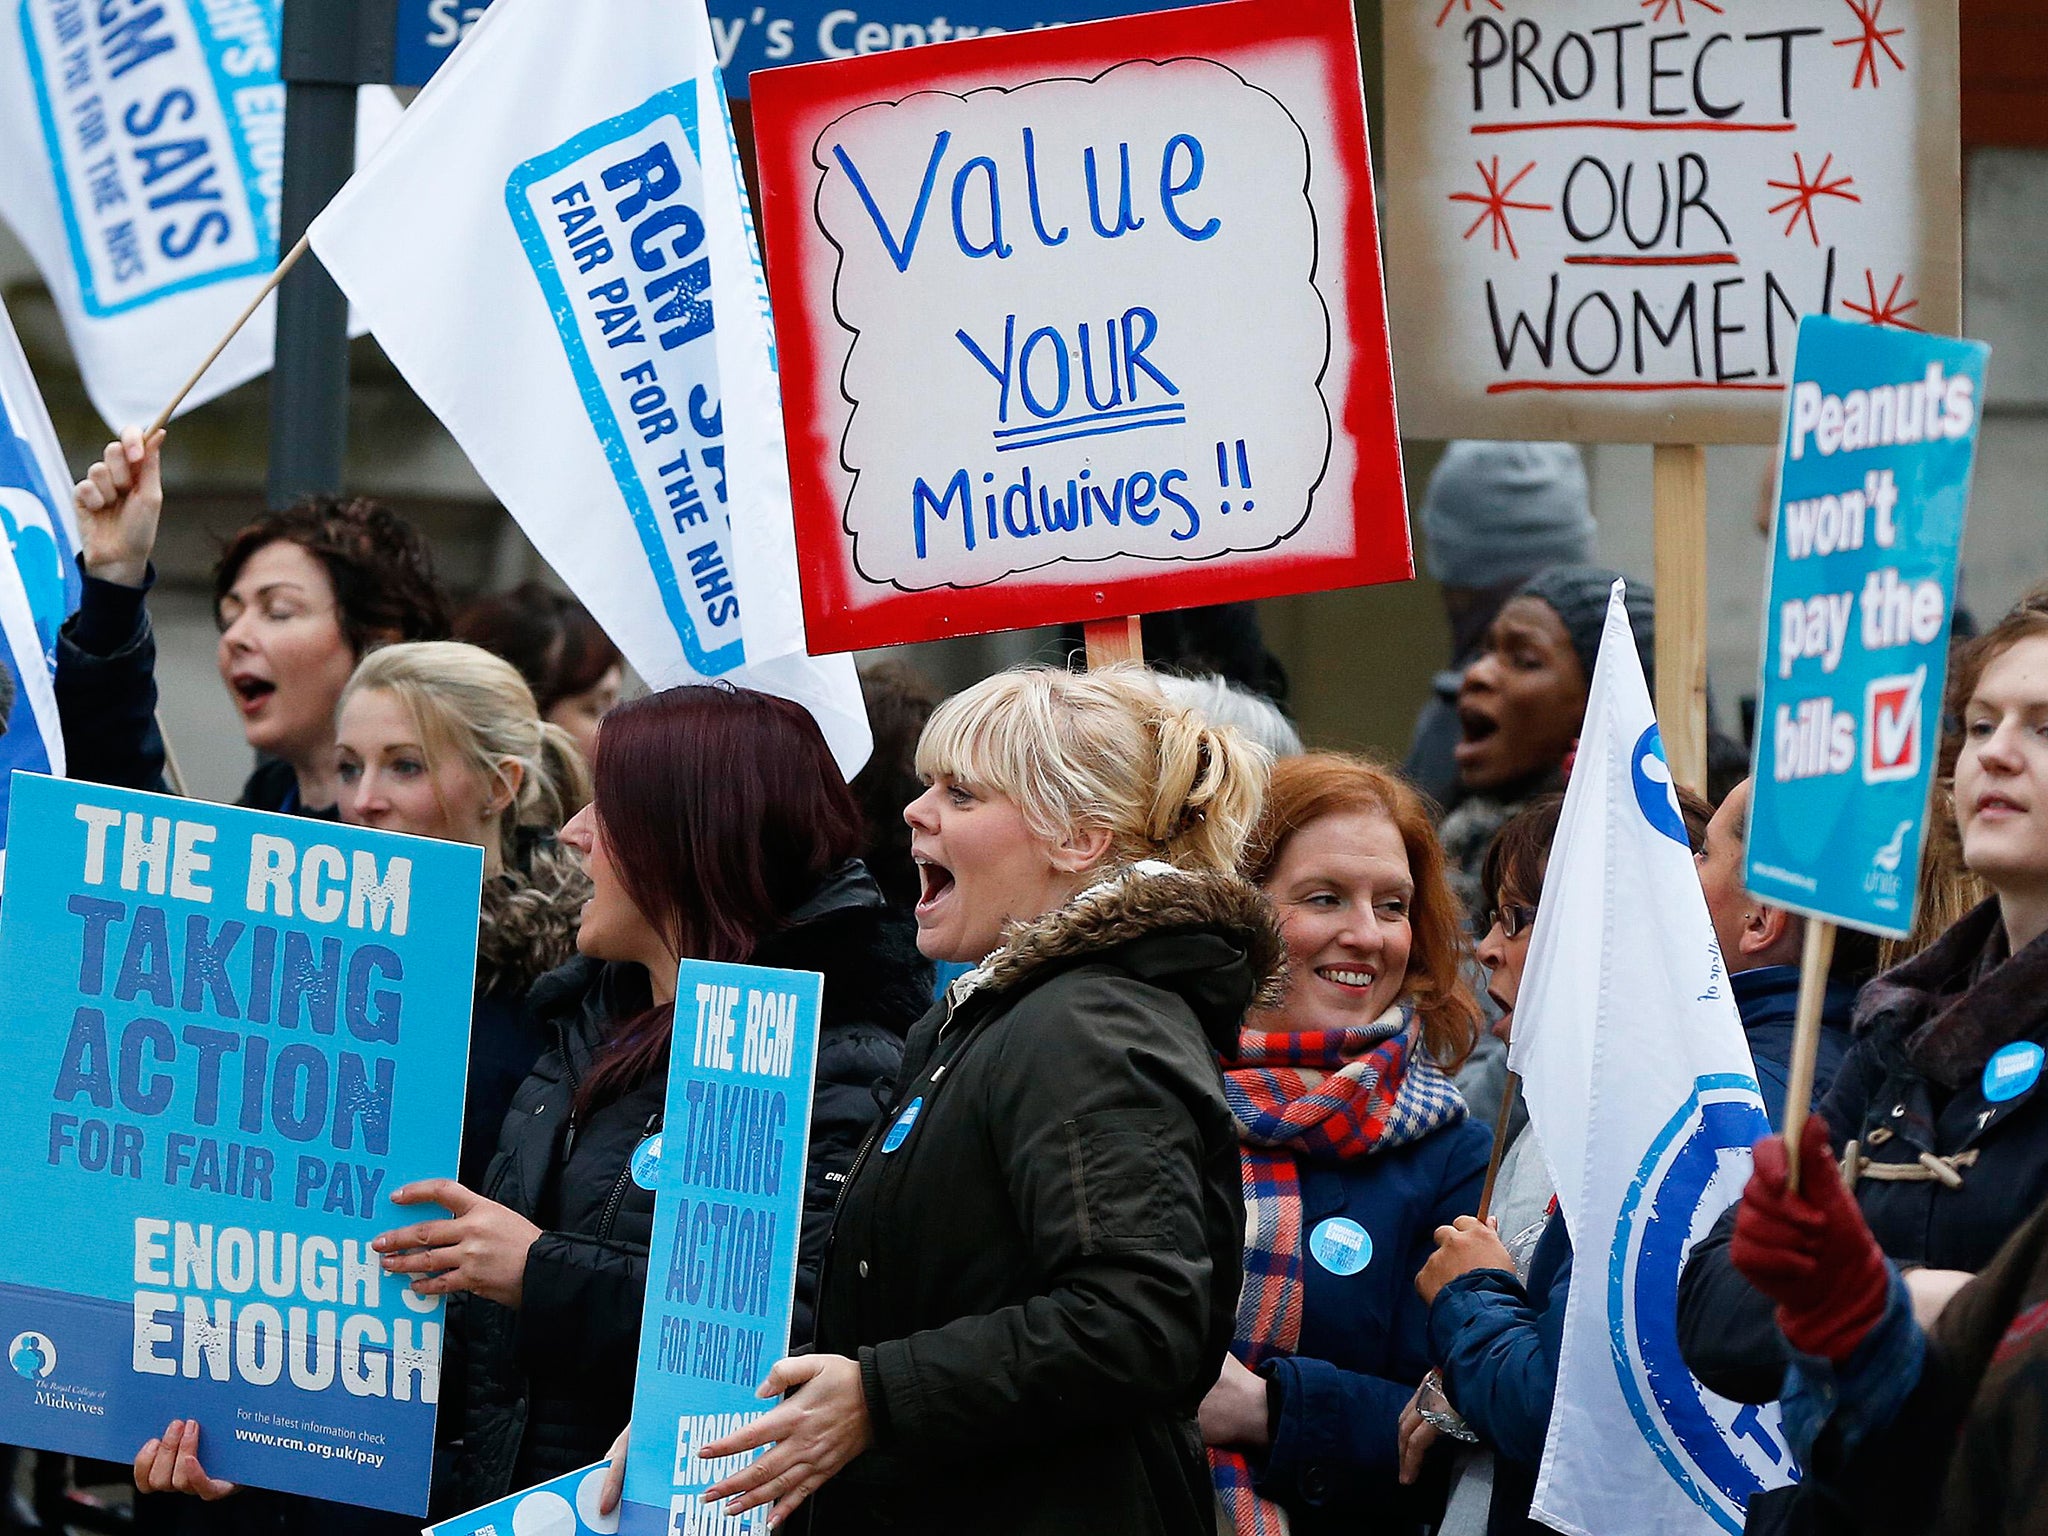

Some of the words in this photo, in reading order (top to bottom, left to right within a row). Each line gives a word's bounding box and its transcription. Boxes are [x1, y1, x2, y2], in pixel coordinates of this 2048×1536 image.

[1463, 15, 1823, 119] PROTECT
[72, 95, 108, 151] FOR
[125, 88, 233, 260] SAYS
[86, 155, 128, 214] THE
[832, 126, 1222, 272] Value
[1562, 152, 1732, 250] OUR
[103, 220, 146, 284] NHS
[600, 141, 715, 351] RCM
[552, 181, 614, 274] FAIR
[588, 277, 645, 348] PAY
[621, 360, 678, 444] FOR
[658, 449, 708, 533] THE
[687, 541, 739, 627] NHS
[955, 306, 1180, 423] YOUR
[1789, 361, 1976, 461] Peanuts
[1784, 468, 1898, 560] won't
[1778, 590, 1854, 679] pay
[1860, 567, 1944, 650] the
[1773, 696, 1857, 783] bills
[74, 803, 218, 903] THE
[246, 833, 413, 936] RCM
[67, 893, 404, 1045] TAKING
[53, 1006, 396, 1156] ACTION
[693, 983, 740, 1071] THE
[742, 989, 797, 1078] RCM
[47, 1112, 145, 1180] FOR
[164, 1131, 274, 1202] FAIR
[295, 1154, 387, 1220] PAY
[682, 1080, 787, 1197] TAKING
[134, 1217, 440, 1314] ENOUGH
[665, 1198, 777, 1318] ACTION
[132, 1290, 441, 1404] ENOUGH
[657, 1315, 691, 1375] FOR
[692, 1320, 730, 1383] FAIR
[732, 1328, 764, 1388] PAY
[34, 1391, 105, 1416] Midwives
[235, 1429, 385, 1468] www.rcm.org.uk/pay
[236, 1408, 252, 1421] For
[254, 1411, 270, 1425] the
[272, 1414, 299, 1430] latest
[301, 1419, 356, 1440] information
[358, 1430, 386, 1445] check
